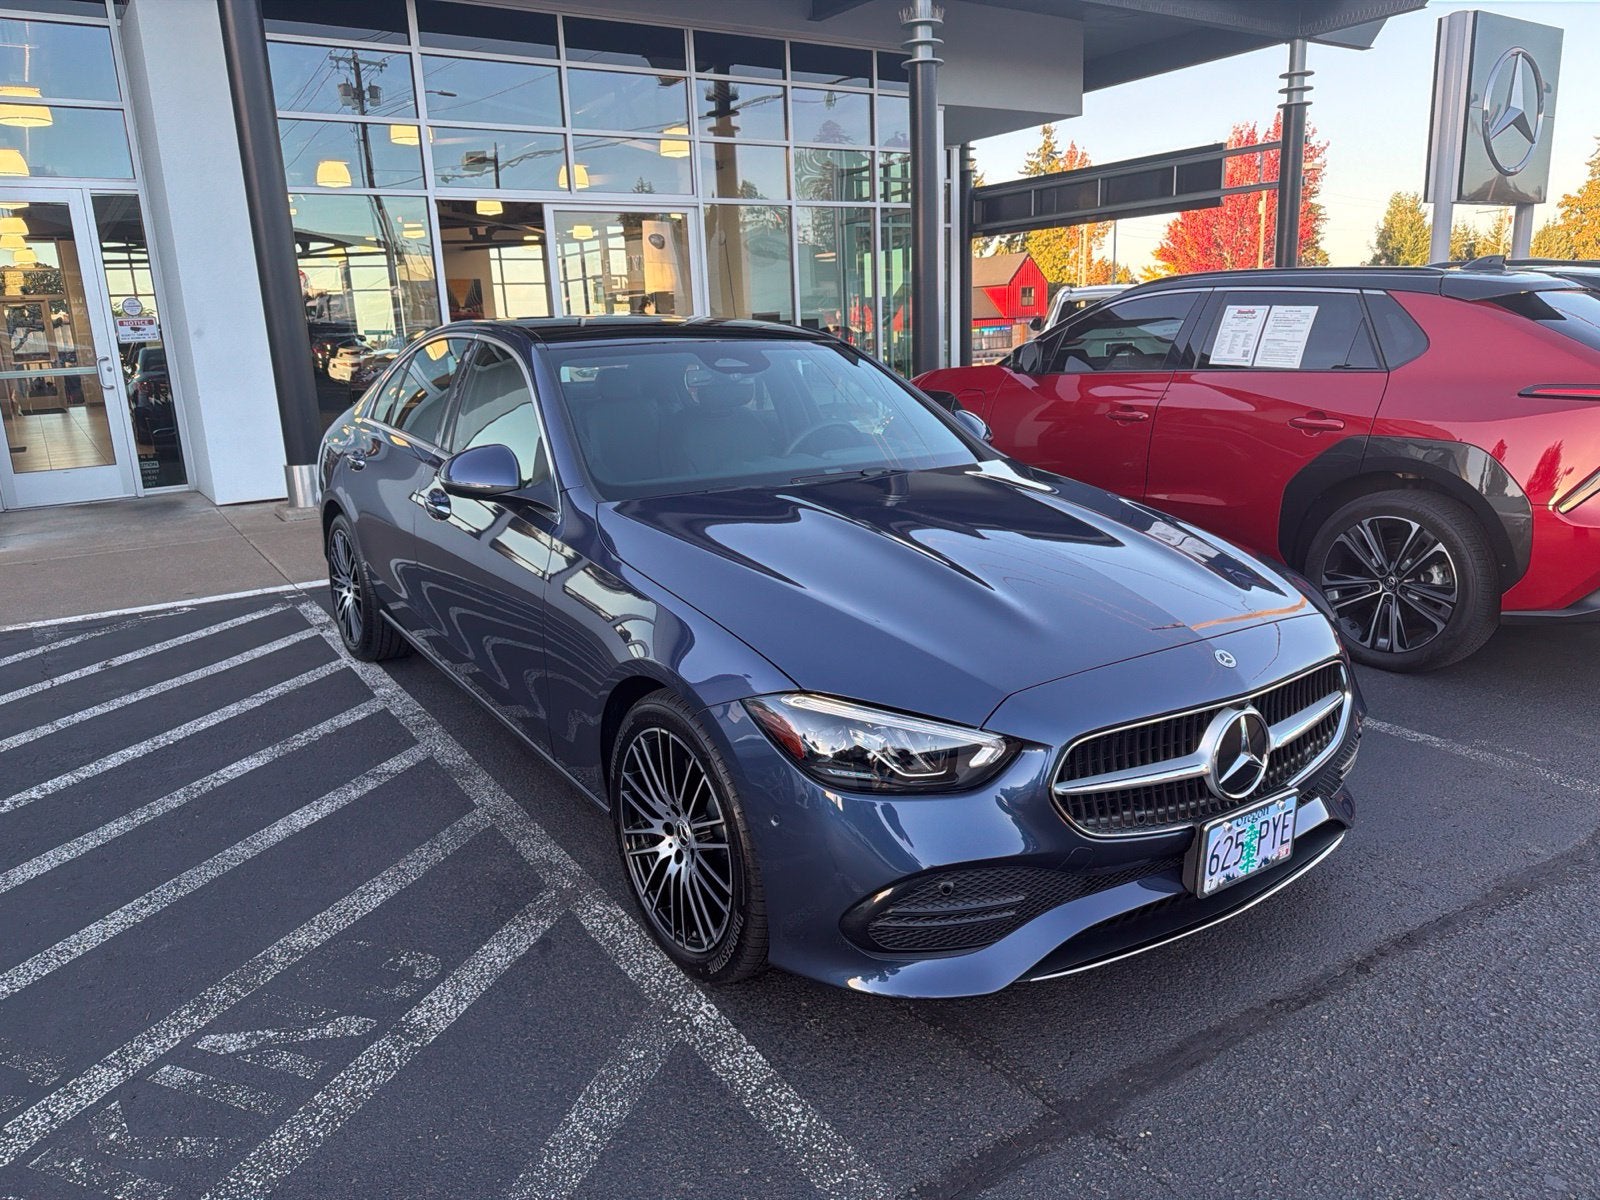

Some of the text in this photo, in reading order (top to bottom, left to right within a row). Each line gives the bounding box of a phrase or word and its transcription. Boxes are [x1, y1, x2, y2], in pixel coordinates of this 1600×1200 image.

[1208, 809, 1293, 876] 625 PYE
[1236, 806, 1269, 827] Oregon
[707, 909, 744, 975] BRIDGESTONE
